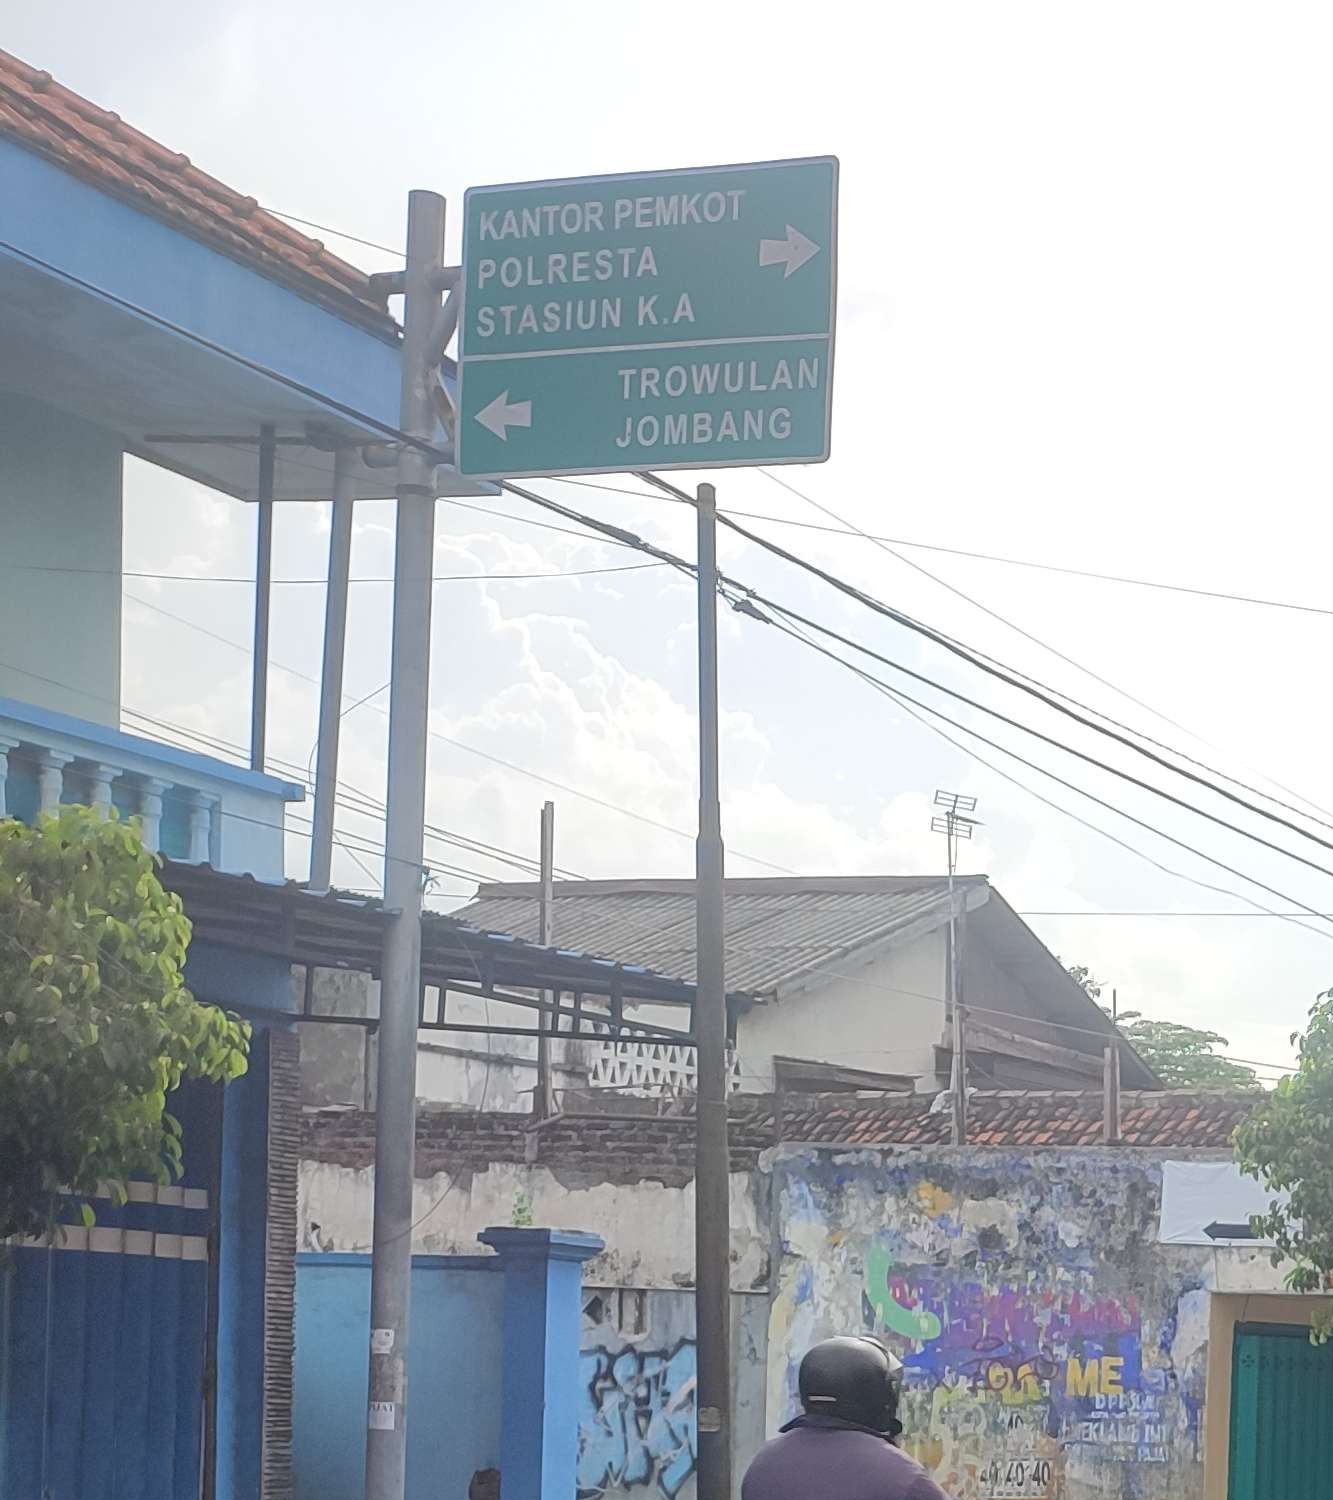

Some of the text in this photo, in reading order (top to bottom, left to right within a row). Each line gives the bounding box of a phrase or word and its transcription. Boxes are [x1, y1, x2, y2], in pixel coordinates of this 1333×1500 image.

[479, 189, 746, 241] KANTOR PEMKOT
[477, 245, 659, 289] POLRESTA
[476, 293, 696, 338] STASIUN K.A
[617, 357, 820, 400] TROWULAN
[615, 407, 793, 448] JOMBANG
